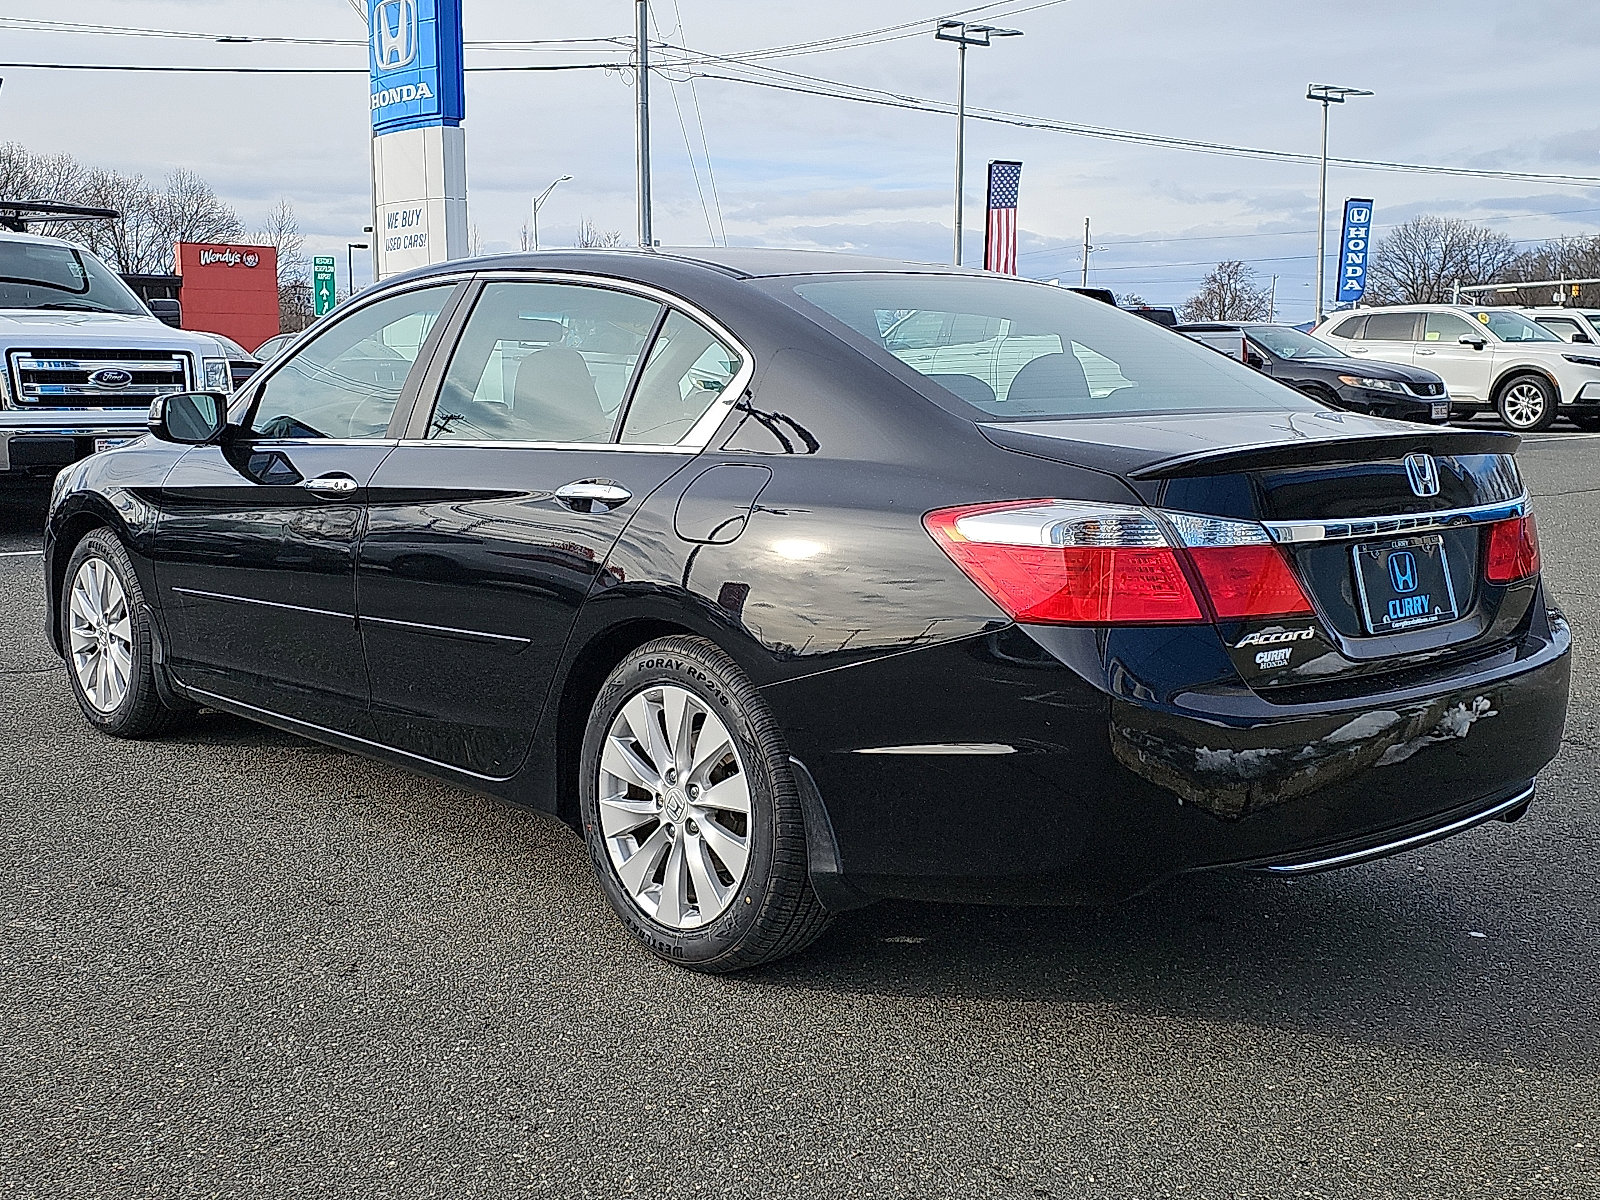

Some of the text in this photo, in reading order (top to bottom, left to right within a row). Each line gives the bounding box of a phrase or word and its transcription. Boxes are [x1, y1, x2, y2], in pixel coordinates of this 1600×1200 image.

[370, 82, 434, 110] HONDA
[387, 208, 422, 230] WE BUY
[385, 233, 427, 252] USED CARS!
[200, 248, 241, 266] Wendy's
[1343, 227, 1368, 291] HONDA
[102, 371, 124, 381] Ford
[1388, 594, 1430, 619] CURRY
[1233, 625, 1316, 649] Accord
[1255, 647, 1293, 664] CURRY
[1260, 659, 1289, 670] HONDA
[637, 658, 730, 708] FORAY RP218
